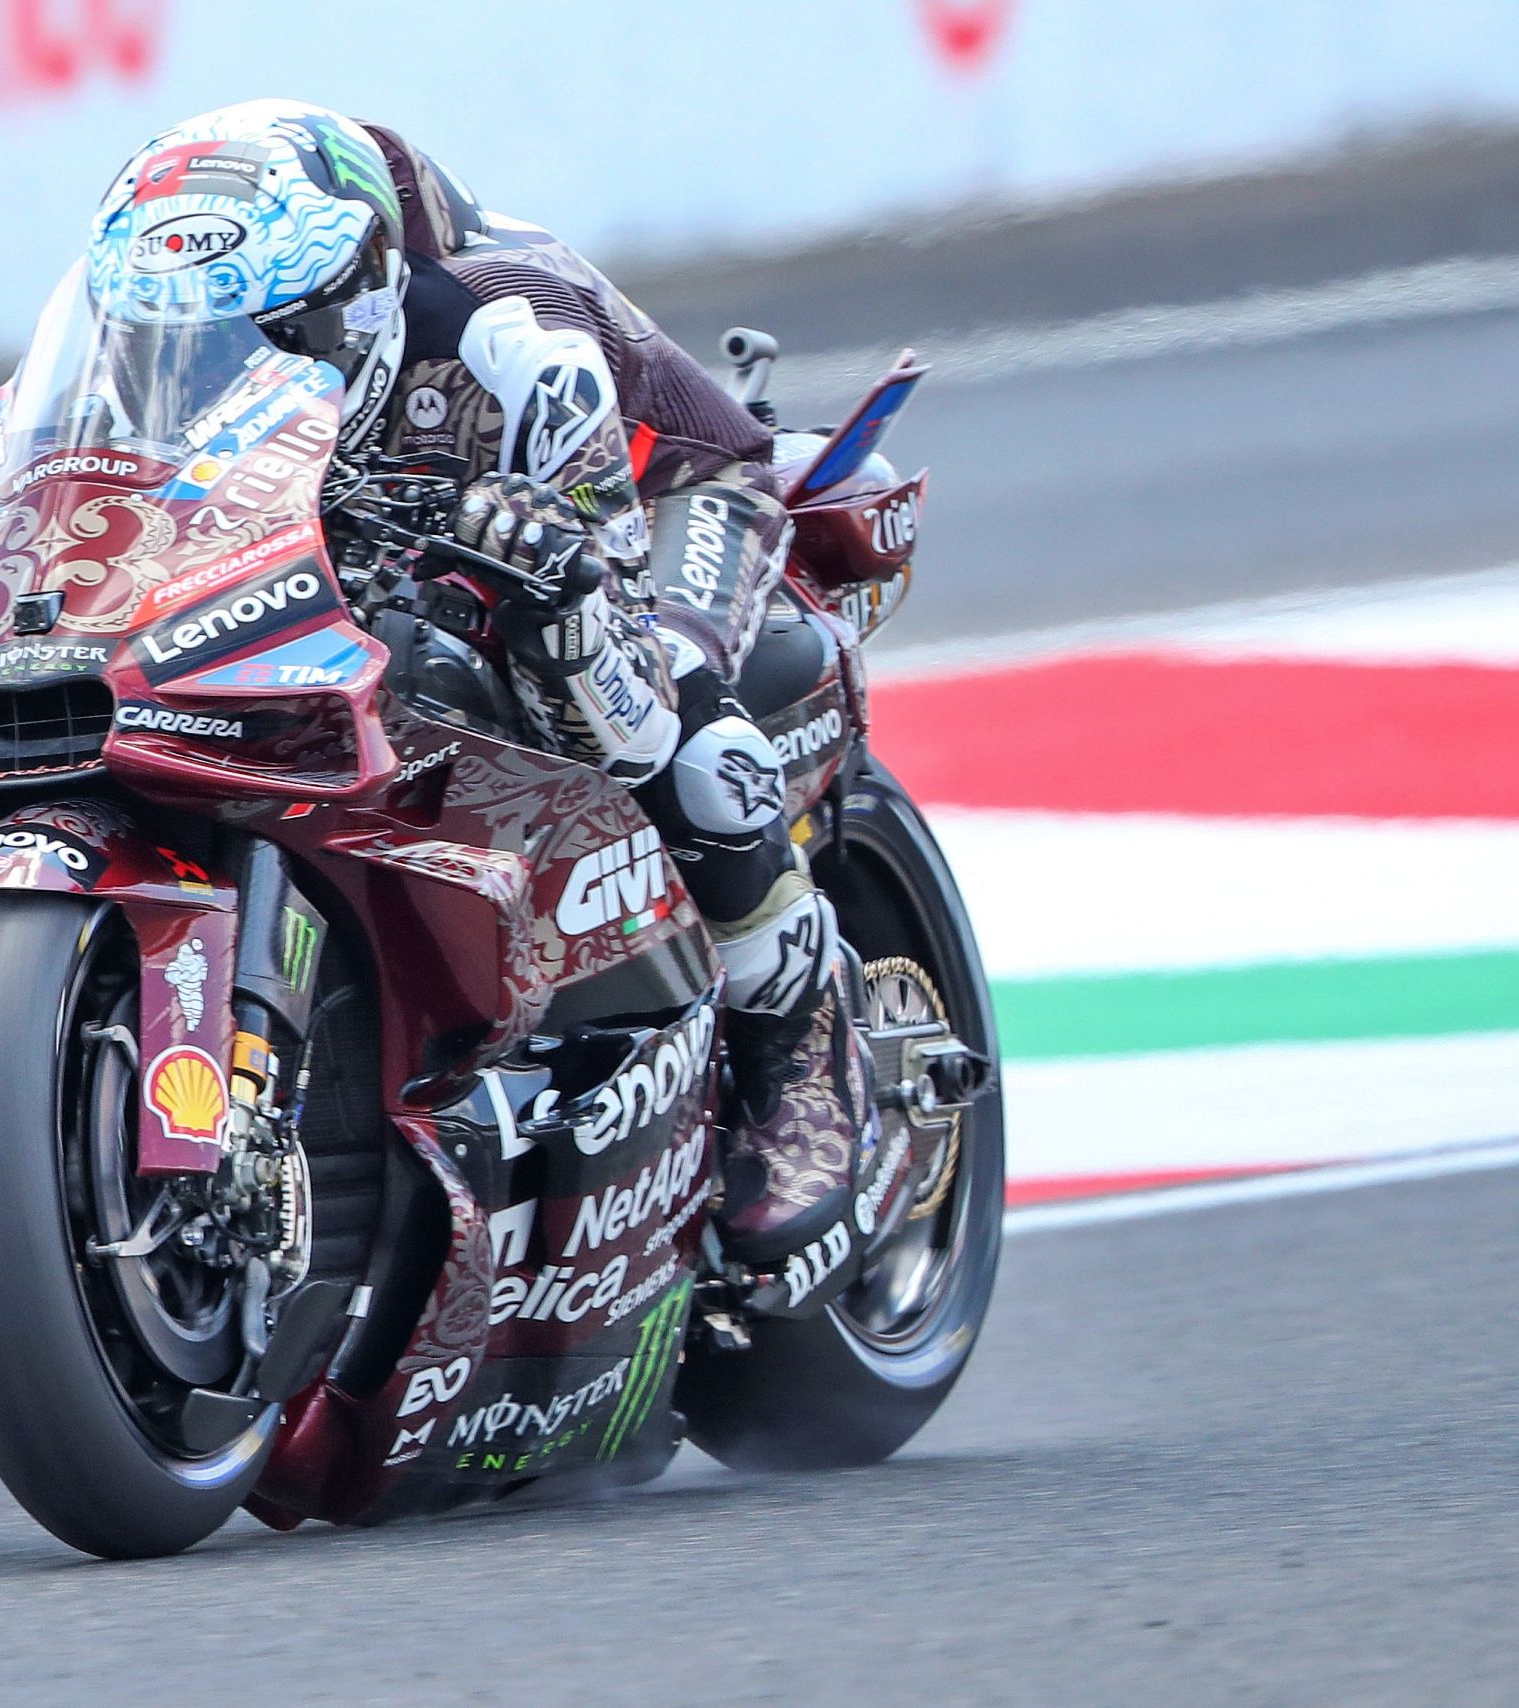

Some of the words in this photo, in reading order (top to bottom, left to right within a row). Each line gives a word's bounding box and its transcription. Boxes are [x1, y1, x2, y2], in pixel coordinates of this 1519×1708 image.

[187, 155, 257, 175] Lenovo
[134, 231, 235, 257] SUOMY
[228, 366, 330, 450] ADVANCE
[154, 525, 315, 604] FRECCIAROSSA
[665, 495, 729, 610] Lenovo
[141, 572, 321, 664] Lenovo
[1, 663, 88, 676] ENERGY
[278, 665, 344, 684] TIM
[115, 706, 243, 739] CARRERA
[772, 708, 843, 766] enovo
[555, 825, 666, 936] GIVI
[561, 1124, 705, 1257] NetApp
[488, 1254, 629, 1325] elica
[446, 1357, 632, 1449] MONSTER
[455, 1418, 594, 1471] ENERGY
